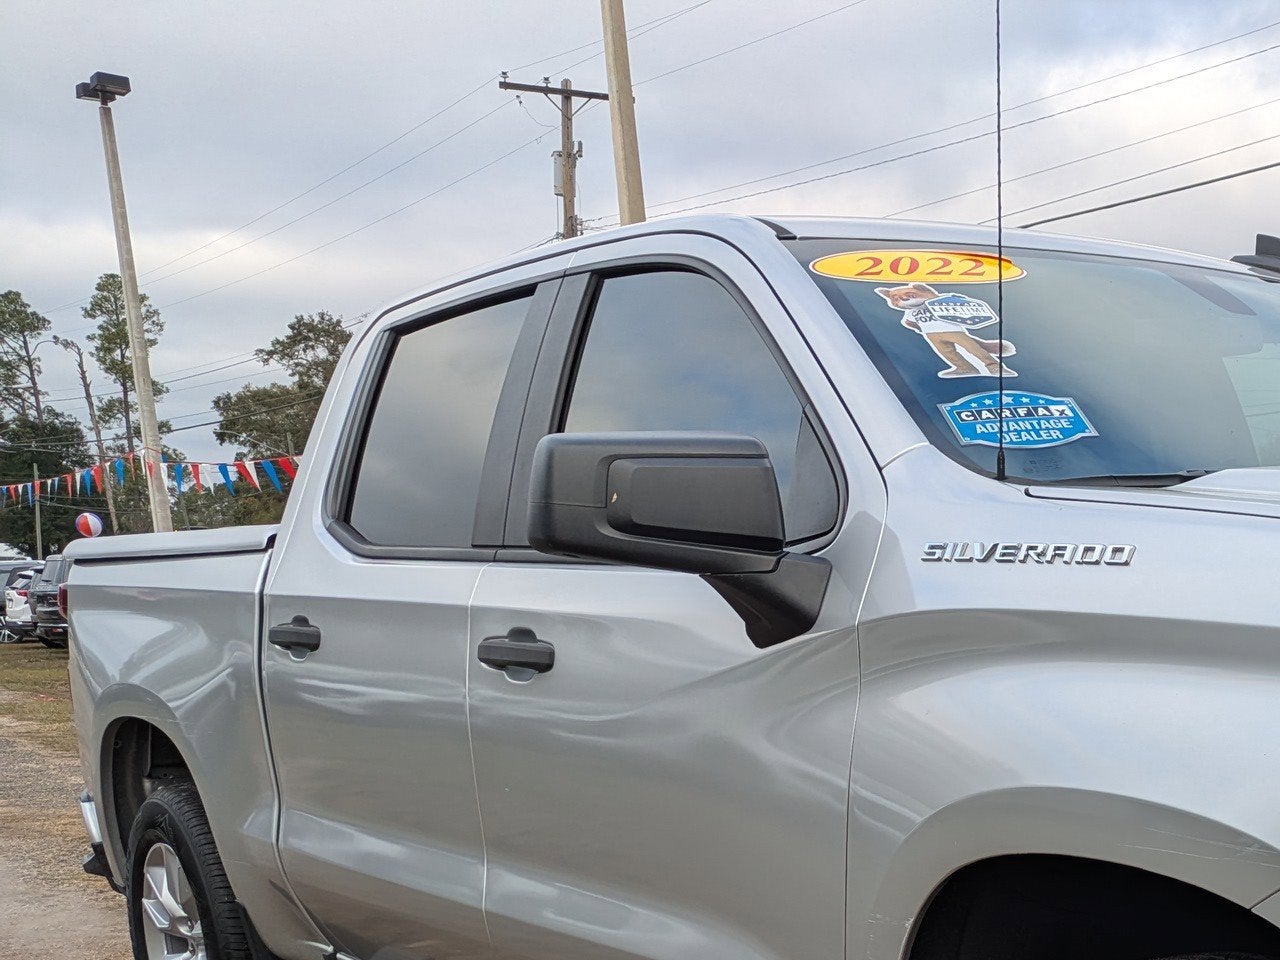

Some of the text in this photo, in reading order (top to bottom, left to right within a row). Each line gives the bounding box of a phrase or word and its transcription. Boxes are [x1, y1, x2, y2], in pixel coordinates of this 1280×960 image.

[854, 256, 987, 277] 2022
[959, 406, 1070, 422] CARFAX
[975, 419, 1073, 434] ADVANTAGE
[997, 429, 1064, 443] DEALER
[921, 541, 1137, 567] SILVERADO
